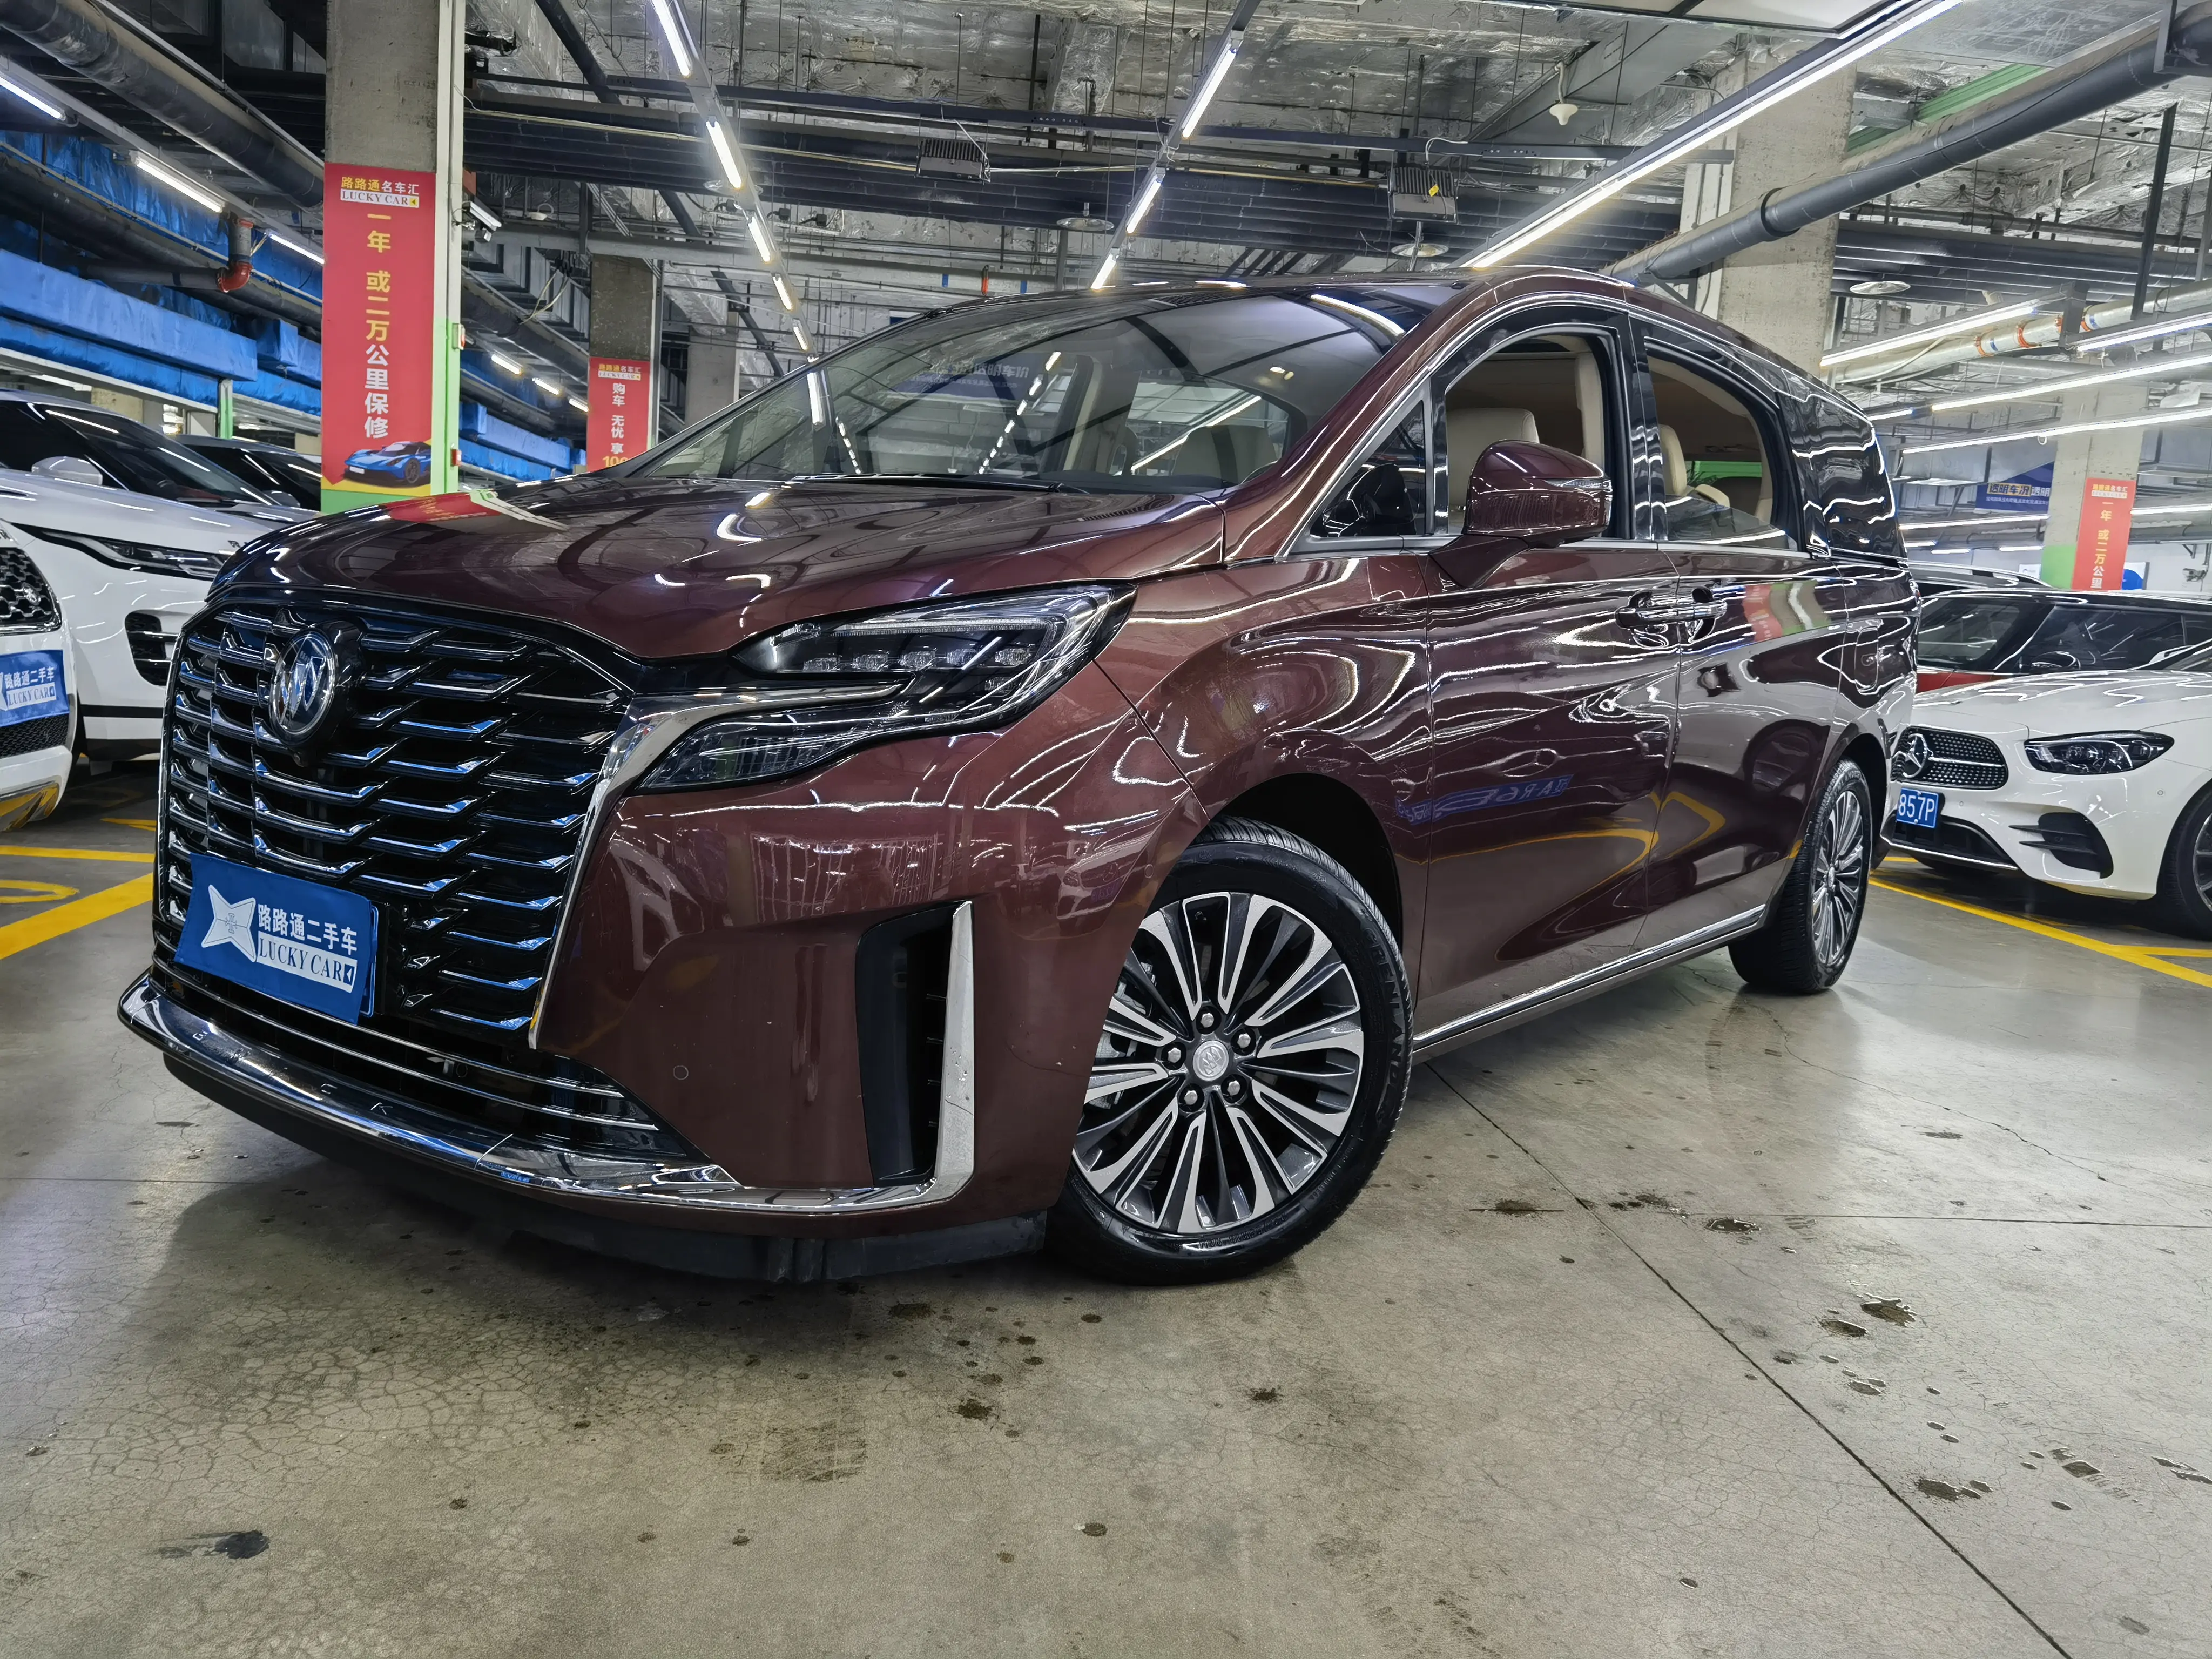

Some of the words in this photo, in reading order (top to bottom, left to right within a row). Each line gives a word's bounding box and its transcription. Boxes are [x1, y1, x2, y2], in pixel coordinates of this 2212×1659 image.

[341, 177, 419, 195] 路路通名车汇
[342, 191, 381, 203] LUCKY
[385, 194, 409, 205] CAR
[367, 213, 392, 254] 一年
[364, 270, 392, 439] 或二万公里保修
[612, 382, 626, 407] 购车
[611, 415, 625, 439] 无忧
[610, 442, 624, 454] 享
[2100, 502, 2114, 522] 一年
[2090, 528, 2110, 589] 或二万公里
[4, 666, 55, 689] 路路通二手车
[8, 689, 33, 706] LUCKY
[34, 686, 50, 701] CAR
[1898, 793, 1935, 821] 857P
[258, 903, 358, 955] 路路通二手车
[259, 938, 308, 969] LUCKY
[311, 954, 344, 983] CAR
